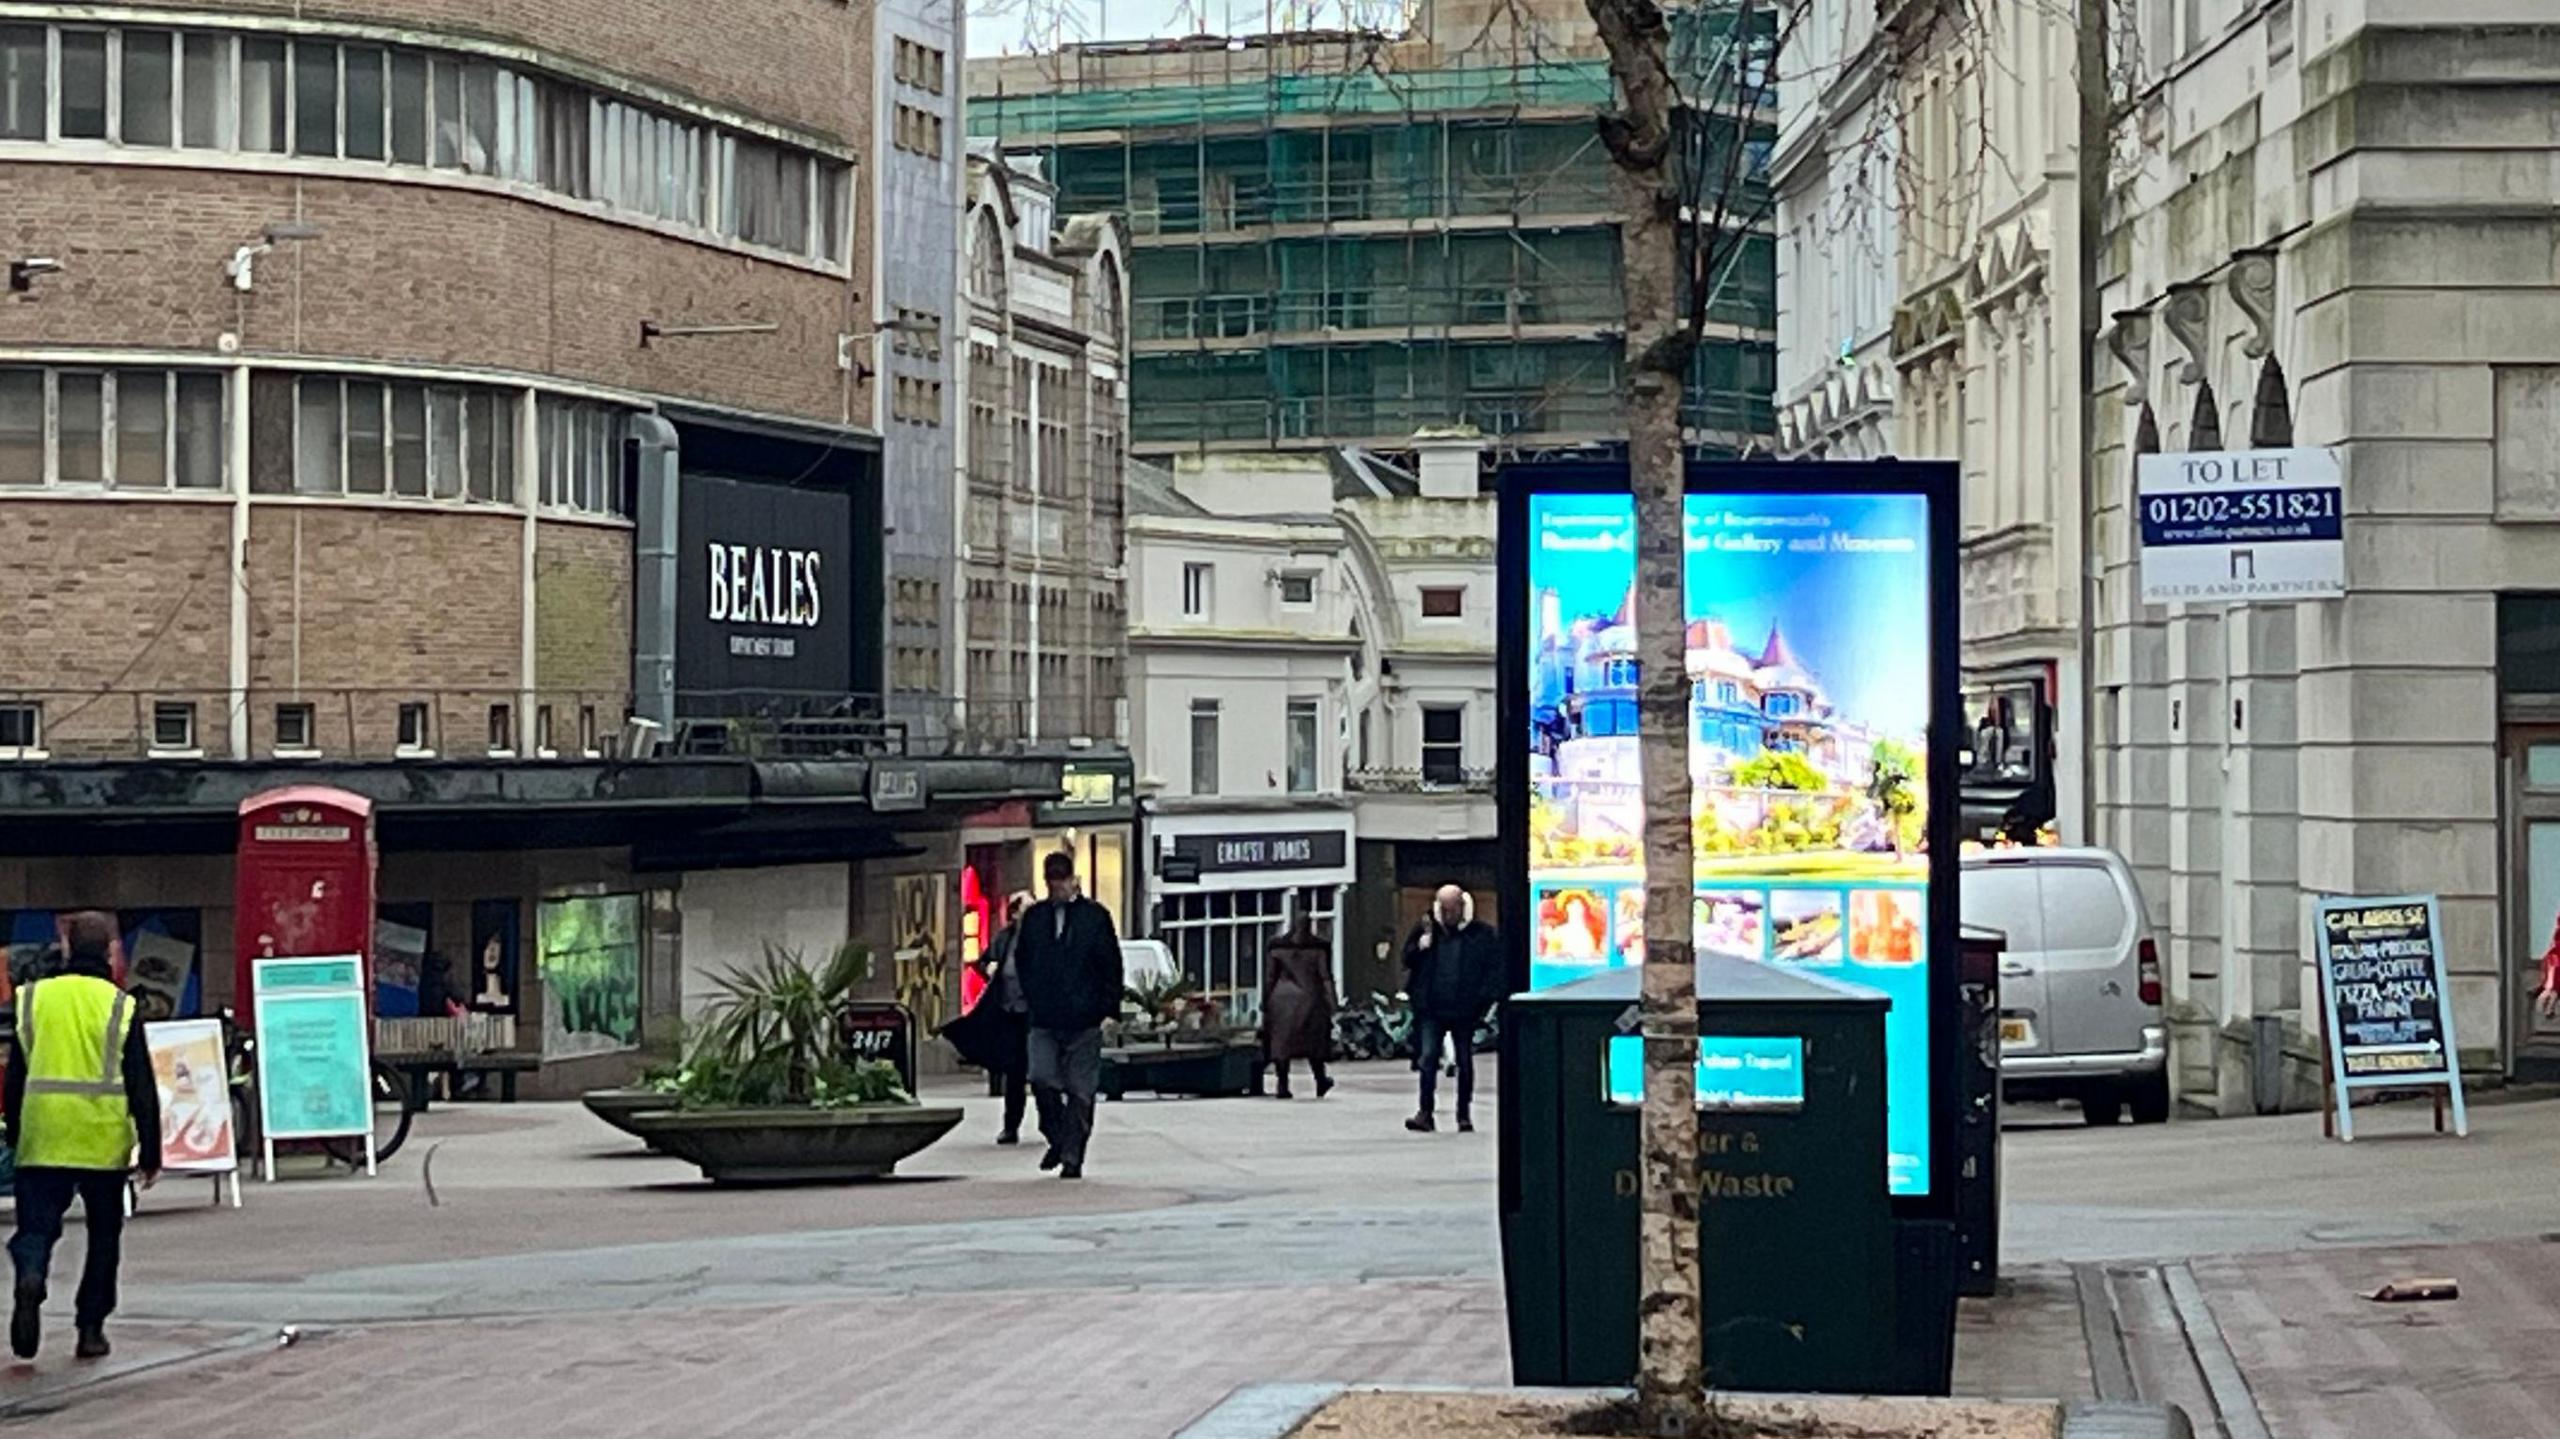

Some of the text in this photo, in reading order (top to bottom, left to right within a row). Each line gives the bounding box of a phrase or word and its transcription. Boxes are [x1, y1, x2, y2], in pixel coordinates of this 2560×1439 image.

[2181, 457, 2288, 484] TO LET
[2150, 492, 2334, 523] 01202-551821
[708, 543, 820, 627] BEALES
[1700, 1170, 1794, 1197] Waste
